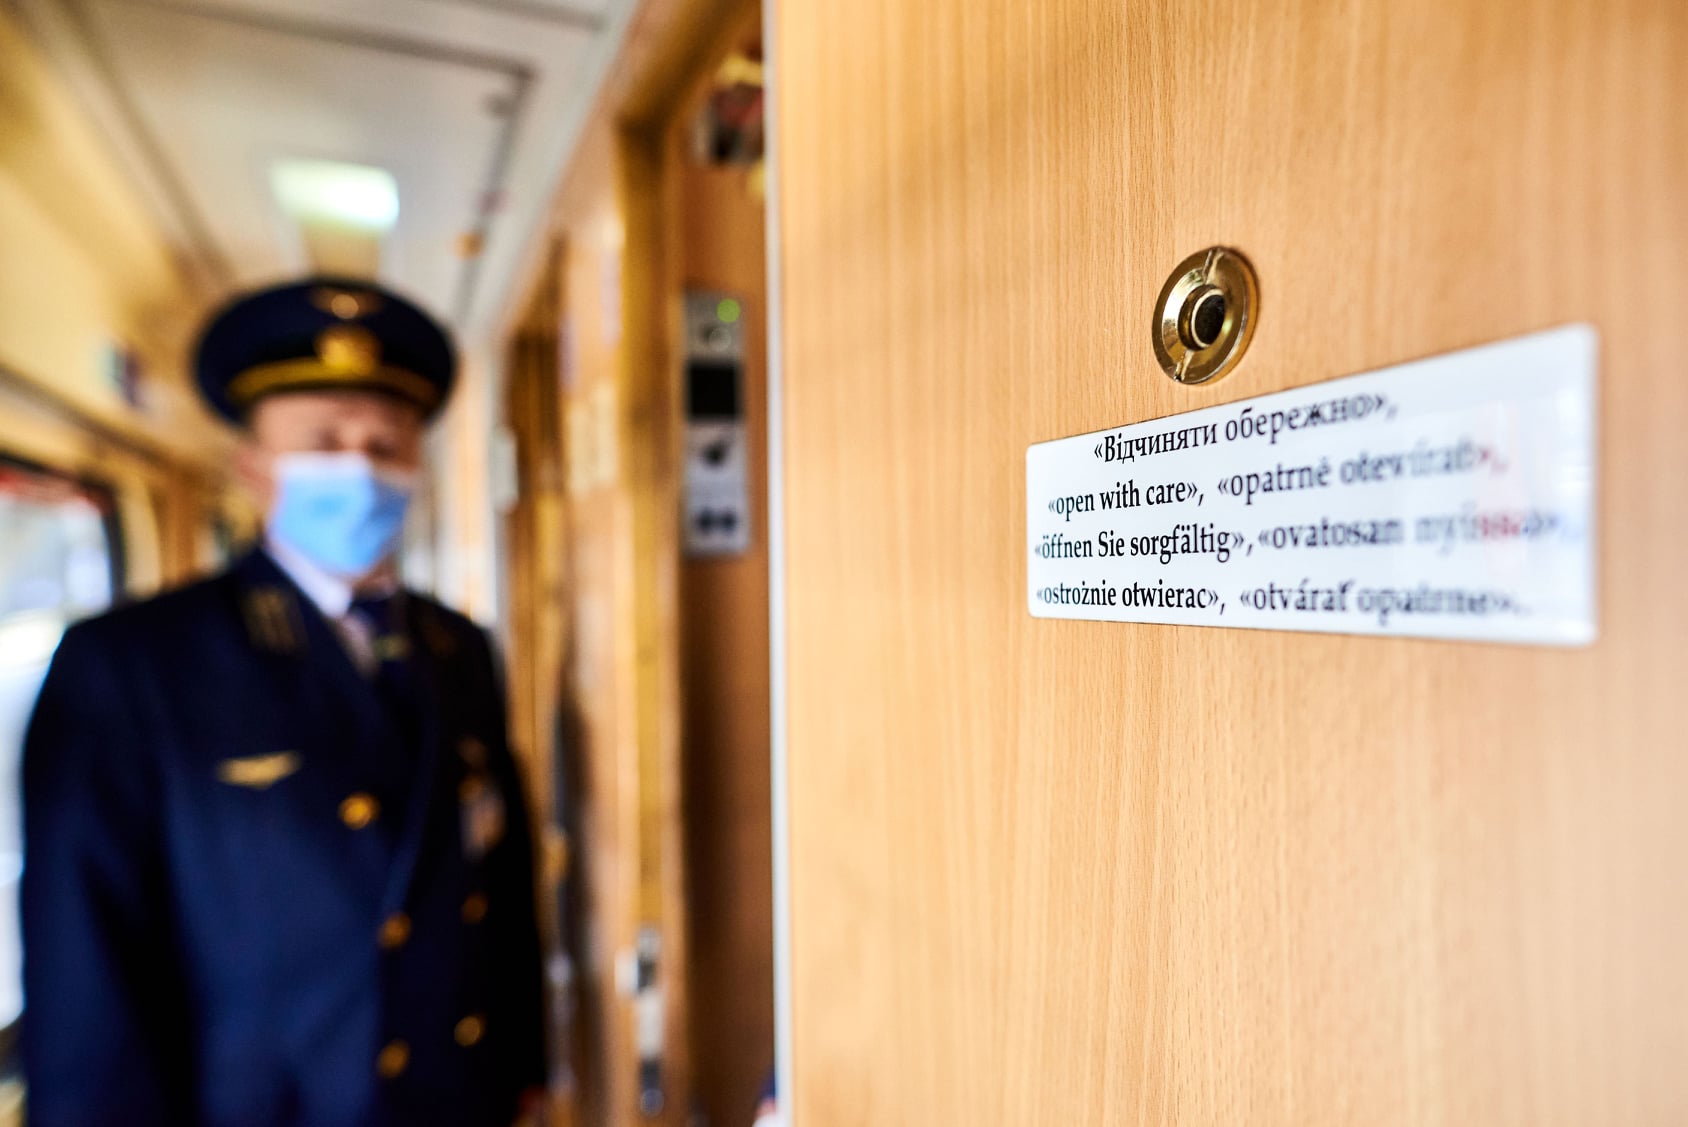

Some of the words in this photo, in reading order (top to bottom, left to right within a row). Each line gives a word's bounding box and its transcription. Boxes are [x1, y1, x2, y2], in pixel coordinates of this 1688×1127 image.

[1094, 423, 1217, 464] «Відчиняти
[1048, 492, 1095, 522] «open
[1099, 479, 1141, 510] with
[1146, 480, 1204, 506] care»,
[1035, 533, 1093, 559] «öffnen
[1098, 530, 1125, 557] Sie
[1036, 579, 1117, 607] «ostrożnie
[1122, 579, 1225, 616] otwierac»,
